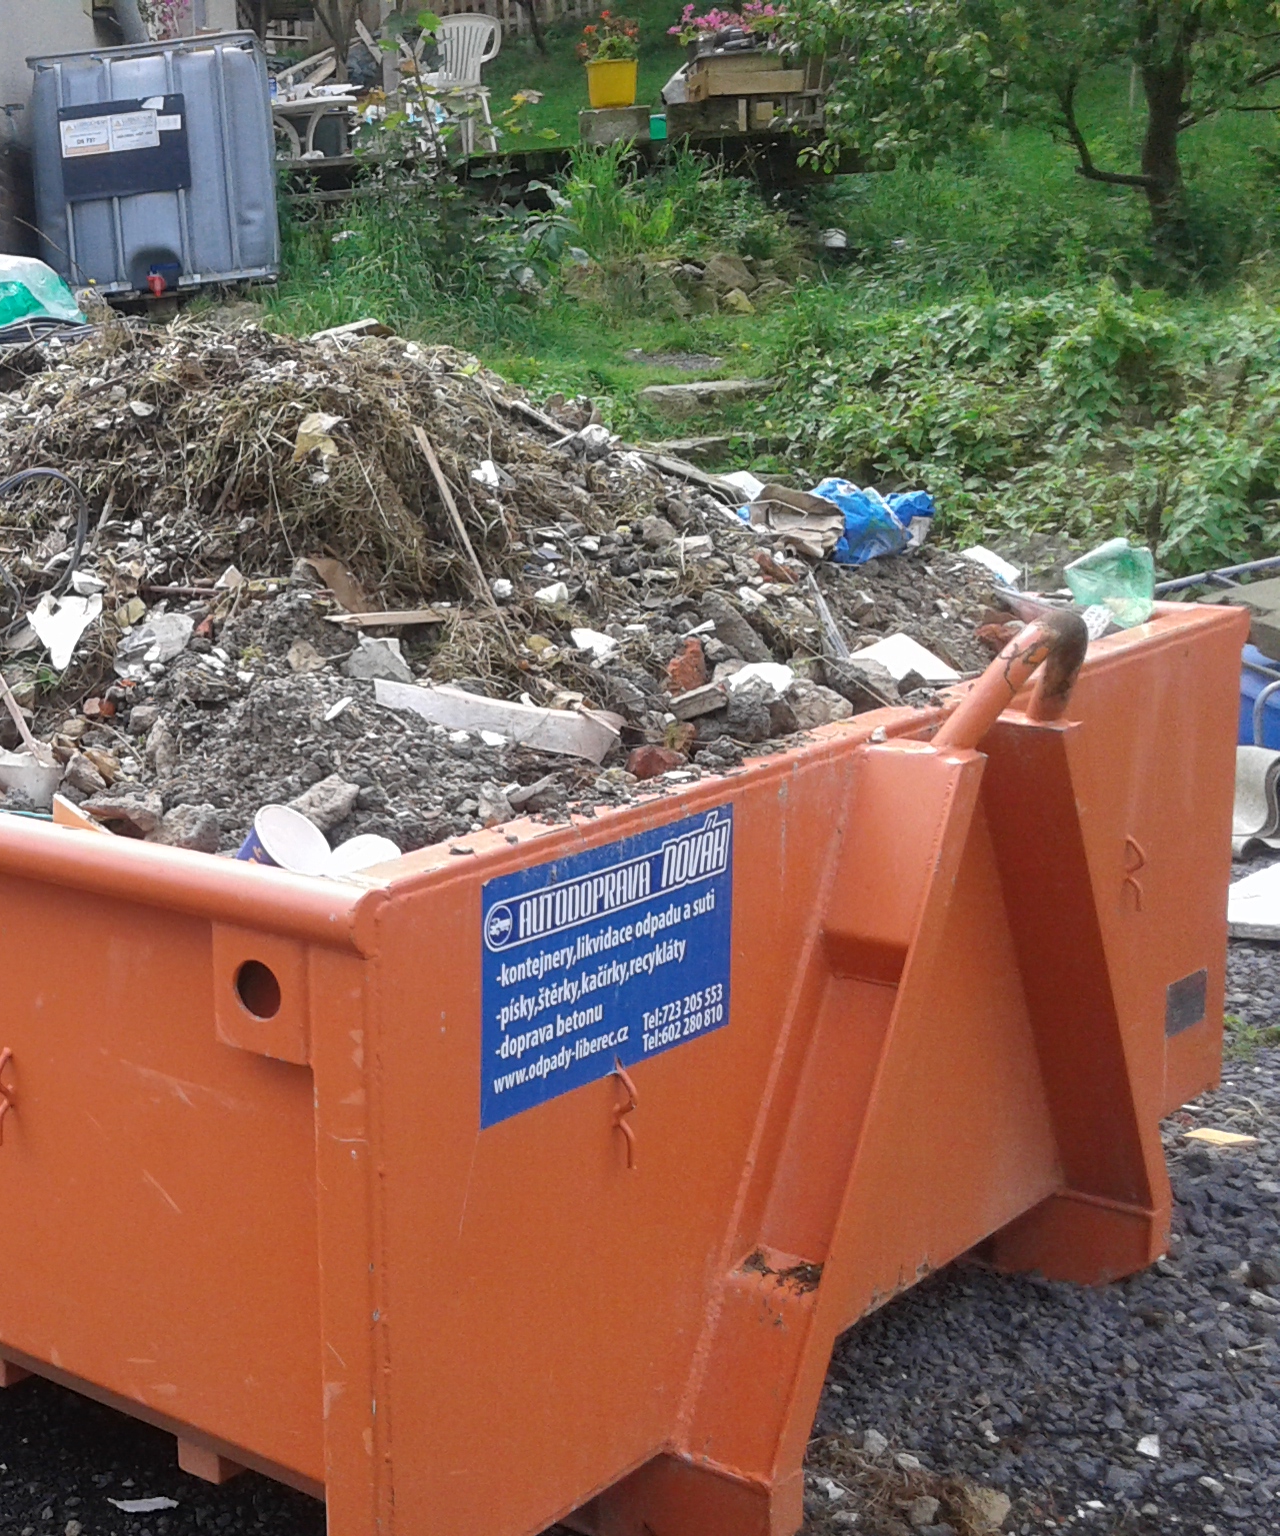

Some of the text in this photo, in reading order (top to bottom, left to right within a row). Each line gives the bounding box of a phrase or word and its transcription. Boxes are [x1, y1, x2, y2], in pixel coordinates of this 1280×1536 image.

[519, 818, 727, 939] AUTODOPRAVA NOVÁK
[635, 903, 681, 939] odpadu
[683, 903, 691, 920] a
[692, 887, 716, 917] suti
[495, 1003, 603, 1060] -doprava betonu
[642, 983, 723, 1031] Tel:723 205 553
[642, 1003, 723, 1052] Tel:602 280 810
[493, 1025, 629, 1095] www.odpady-liberec.cz
